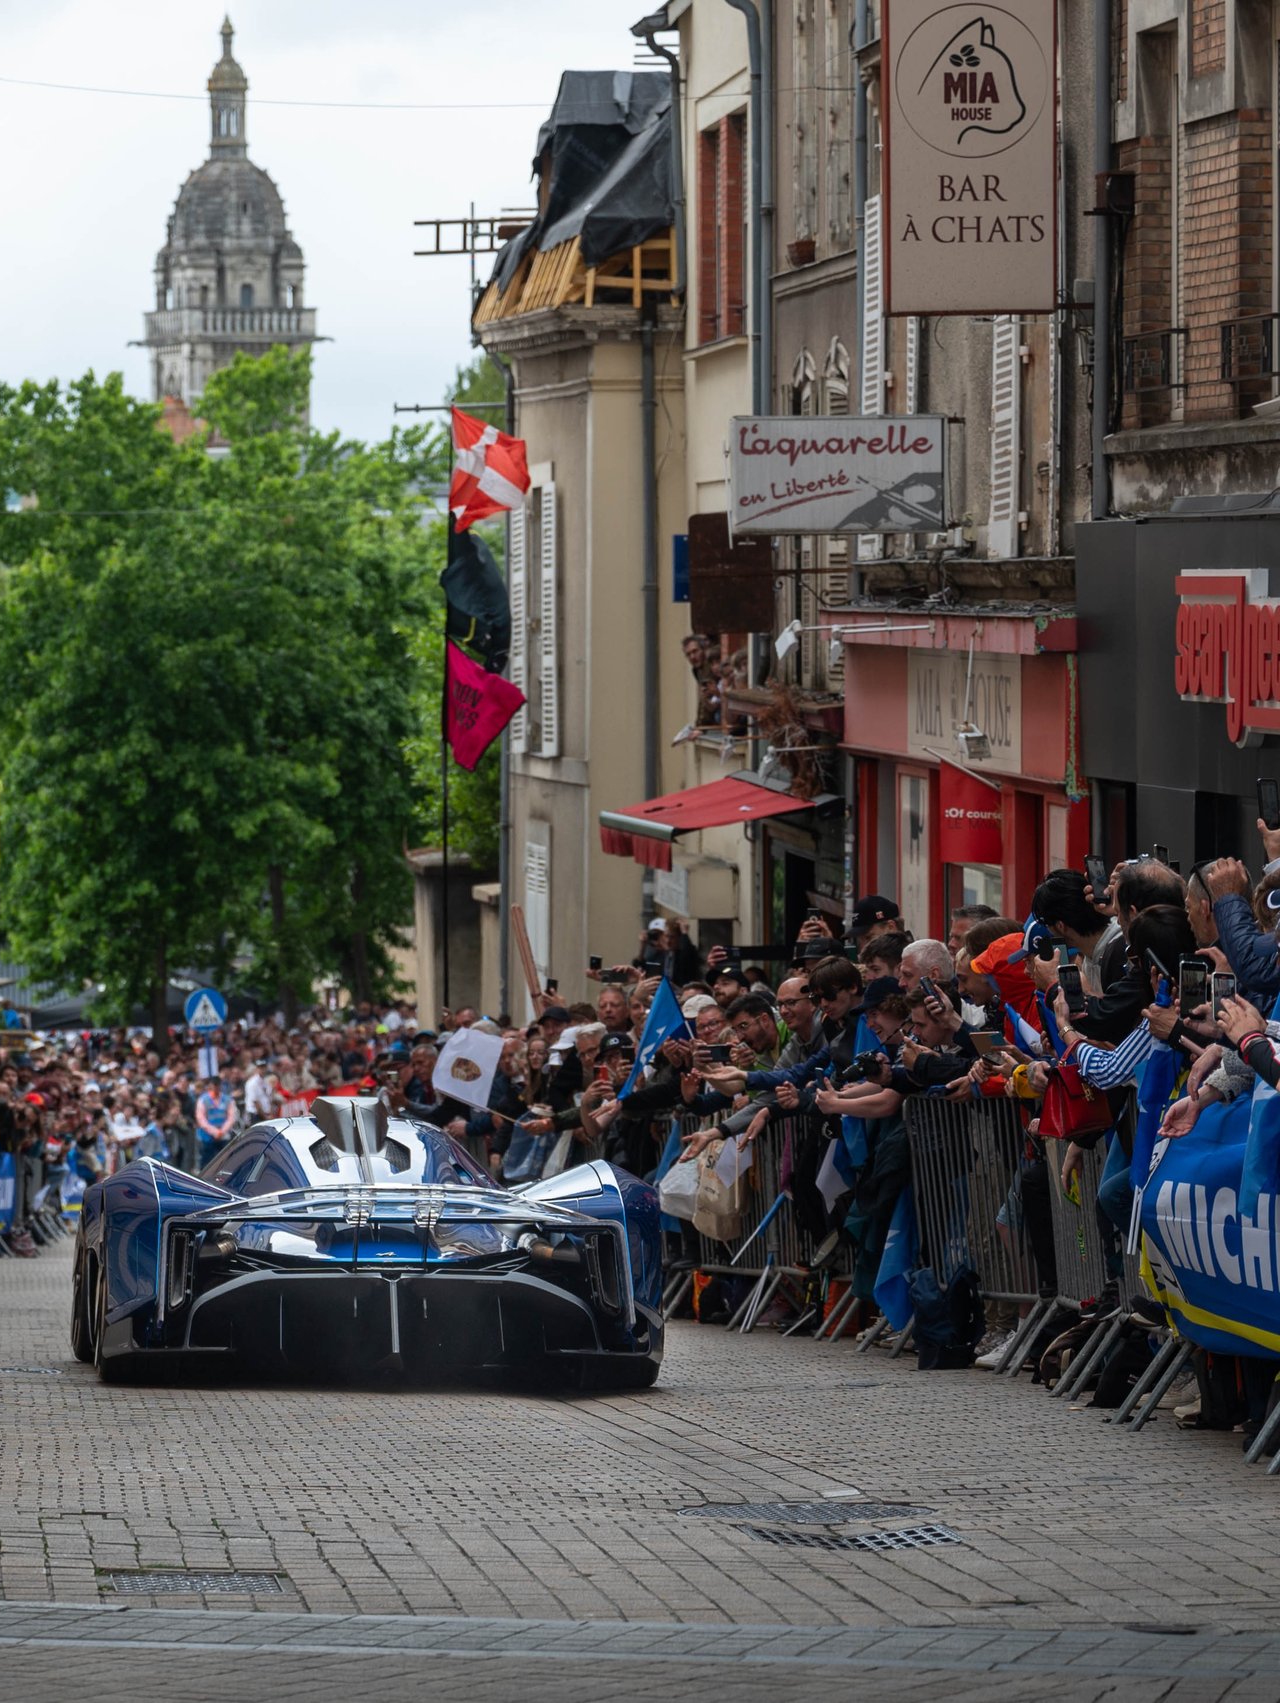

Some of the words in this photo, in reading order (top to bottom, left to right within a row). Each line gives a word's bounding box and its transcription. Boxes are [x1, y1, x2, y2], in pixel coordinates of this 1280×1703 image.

[943, 72, 1000, 104] MIA
[951, 107, 992, 121] HOUSE
[938, 174, 1008, 202] BAR
[901, 213, 922, 242] À
[931, 214, 1045, 243] CHATS
[739, 494, 766, 507] en
[771, 469, 850, 500] Liberté
[1156, 1180, 1280, 1292] MICH
